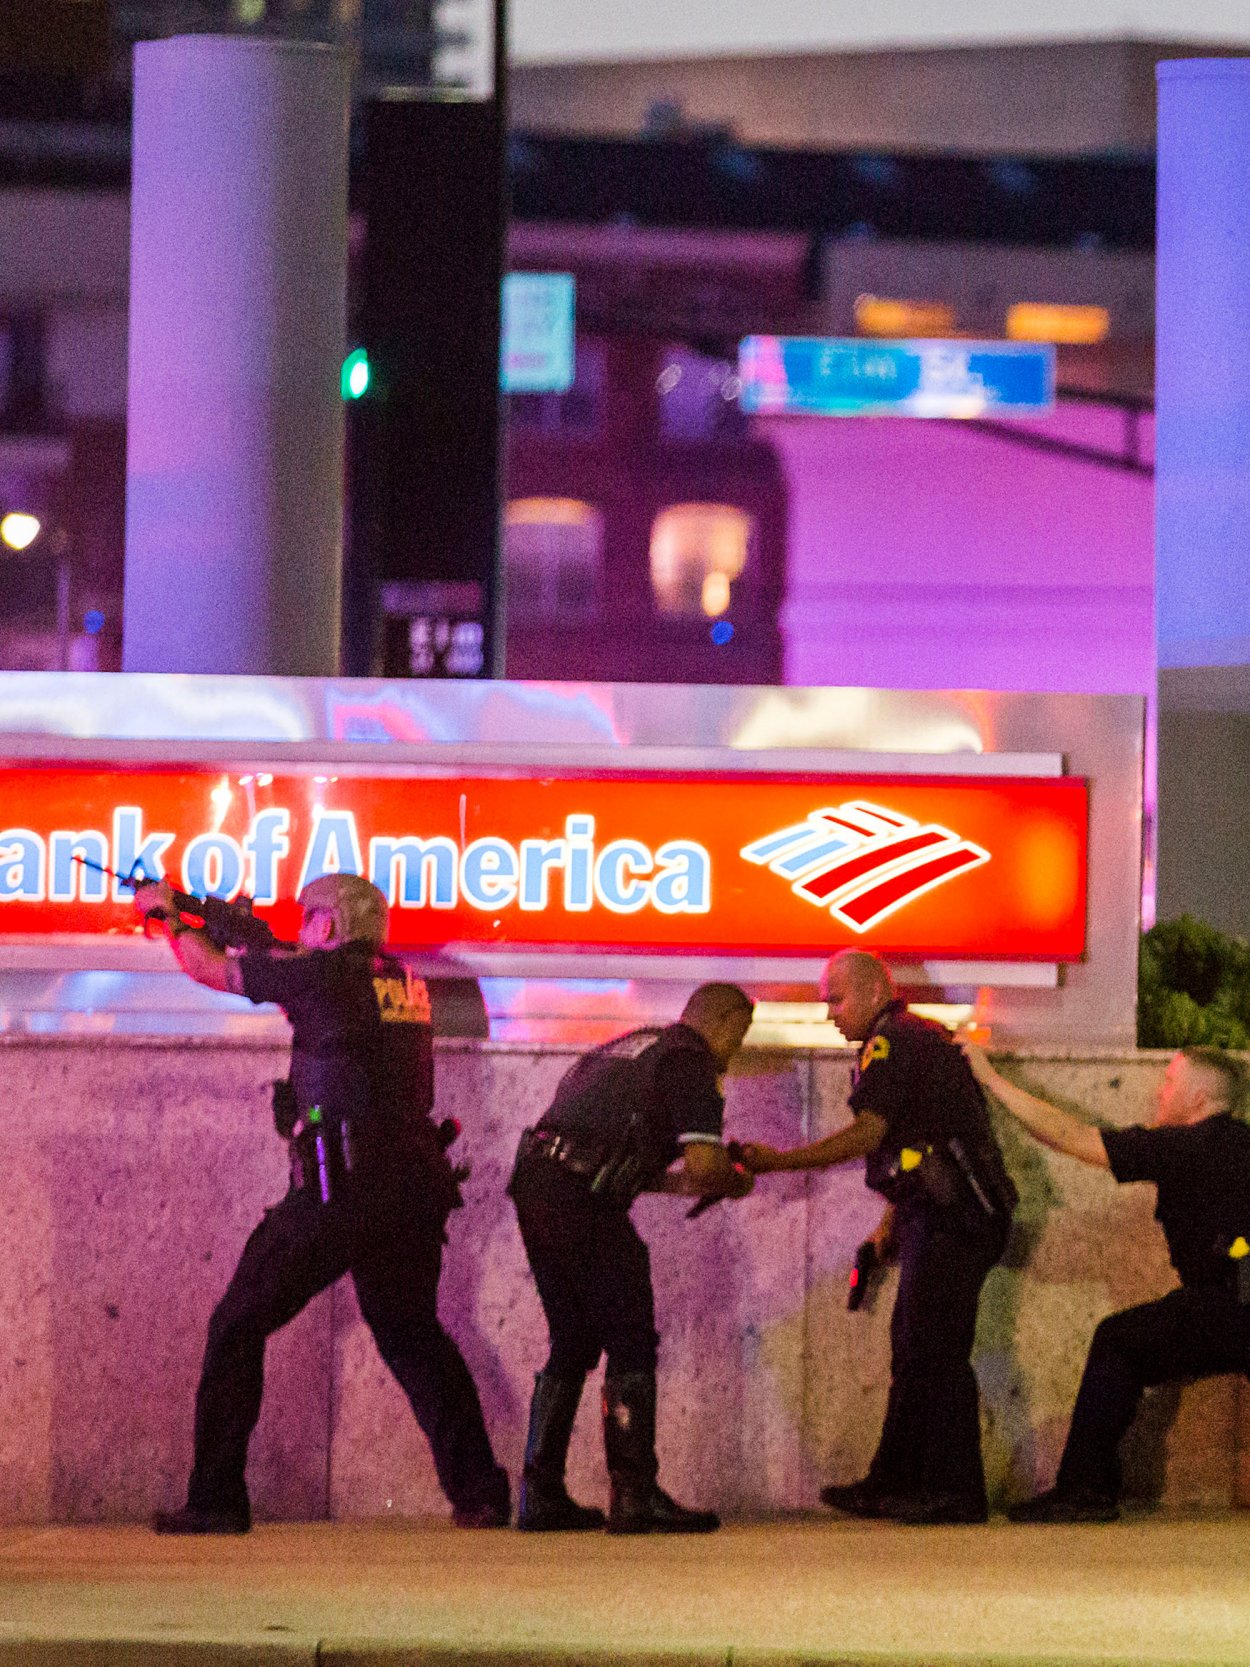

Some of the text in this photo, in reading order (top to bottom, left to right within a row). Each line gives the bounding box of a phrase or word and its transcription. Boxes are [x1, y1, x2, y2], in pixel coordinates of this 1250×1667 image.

[0, 806, 712, 914] ank of America
